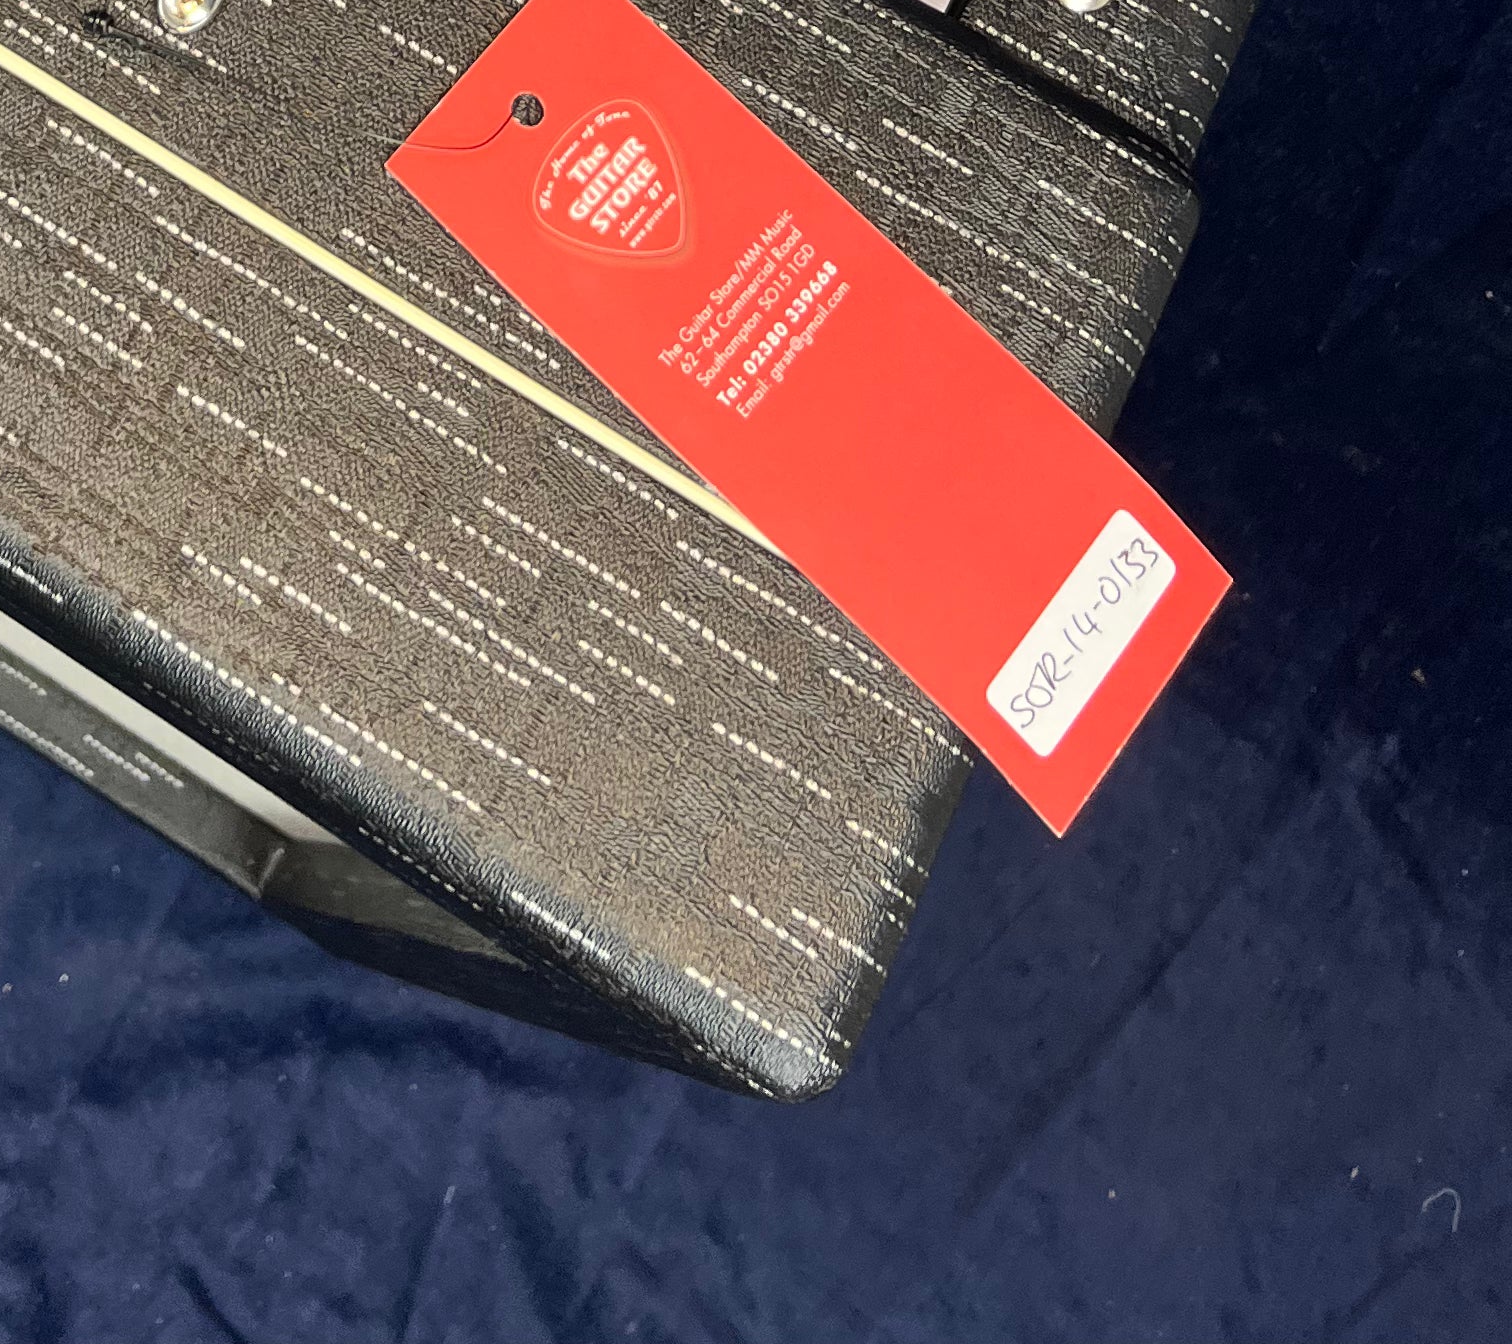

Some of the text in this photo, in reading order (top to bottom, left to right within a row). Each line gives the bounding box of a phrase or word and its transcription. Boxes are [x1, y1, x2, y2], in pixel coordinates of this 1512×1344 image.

[566, 143, 610, 184] The
[568, 136, 646, 220] GUITAR
[590, 157, 657, 234] STORE
[658, 210, 792, 366] The Guitar Store/MM Music
[696, 244, 814, 387] Southampton SO15 1GD
[716, 256, 776, 328] Commercial
[771, 224, 802, 261] Road
[716, 261, 837, 406] Tel: 02380 339668
[736, 378, 772, 418] Email:
